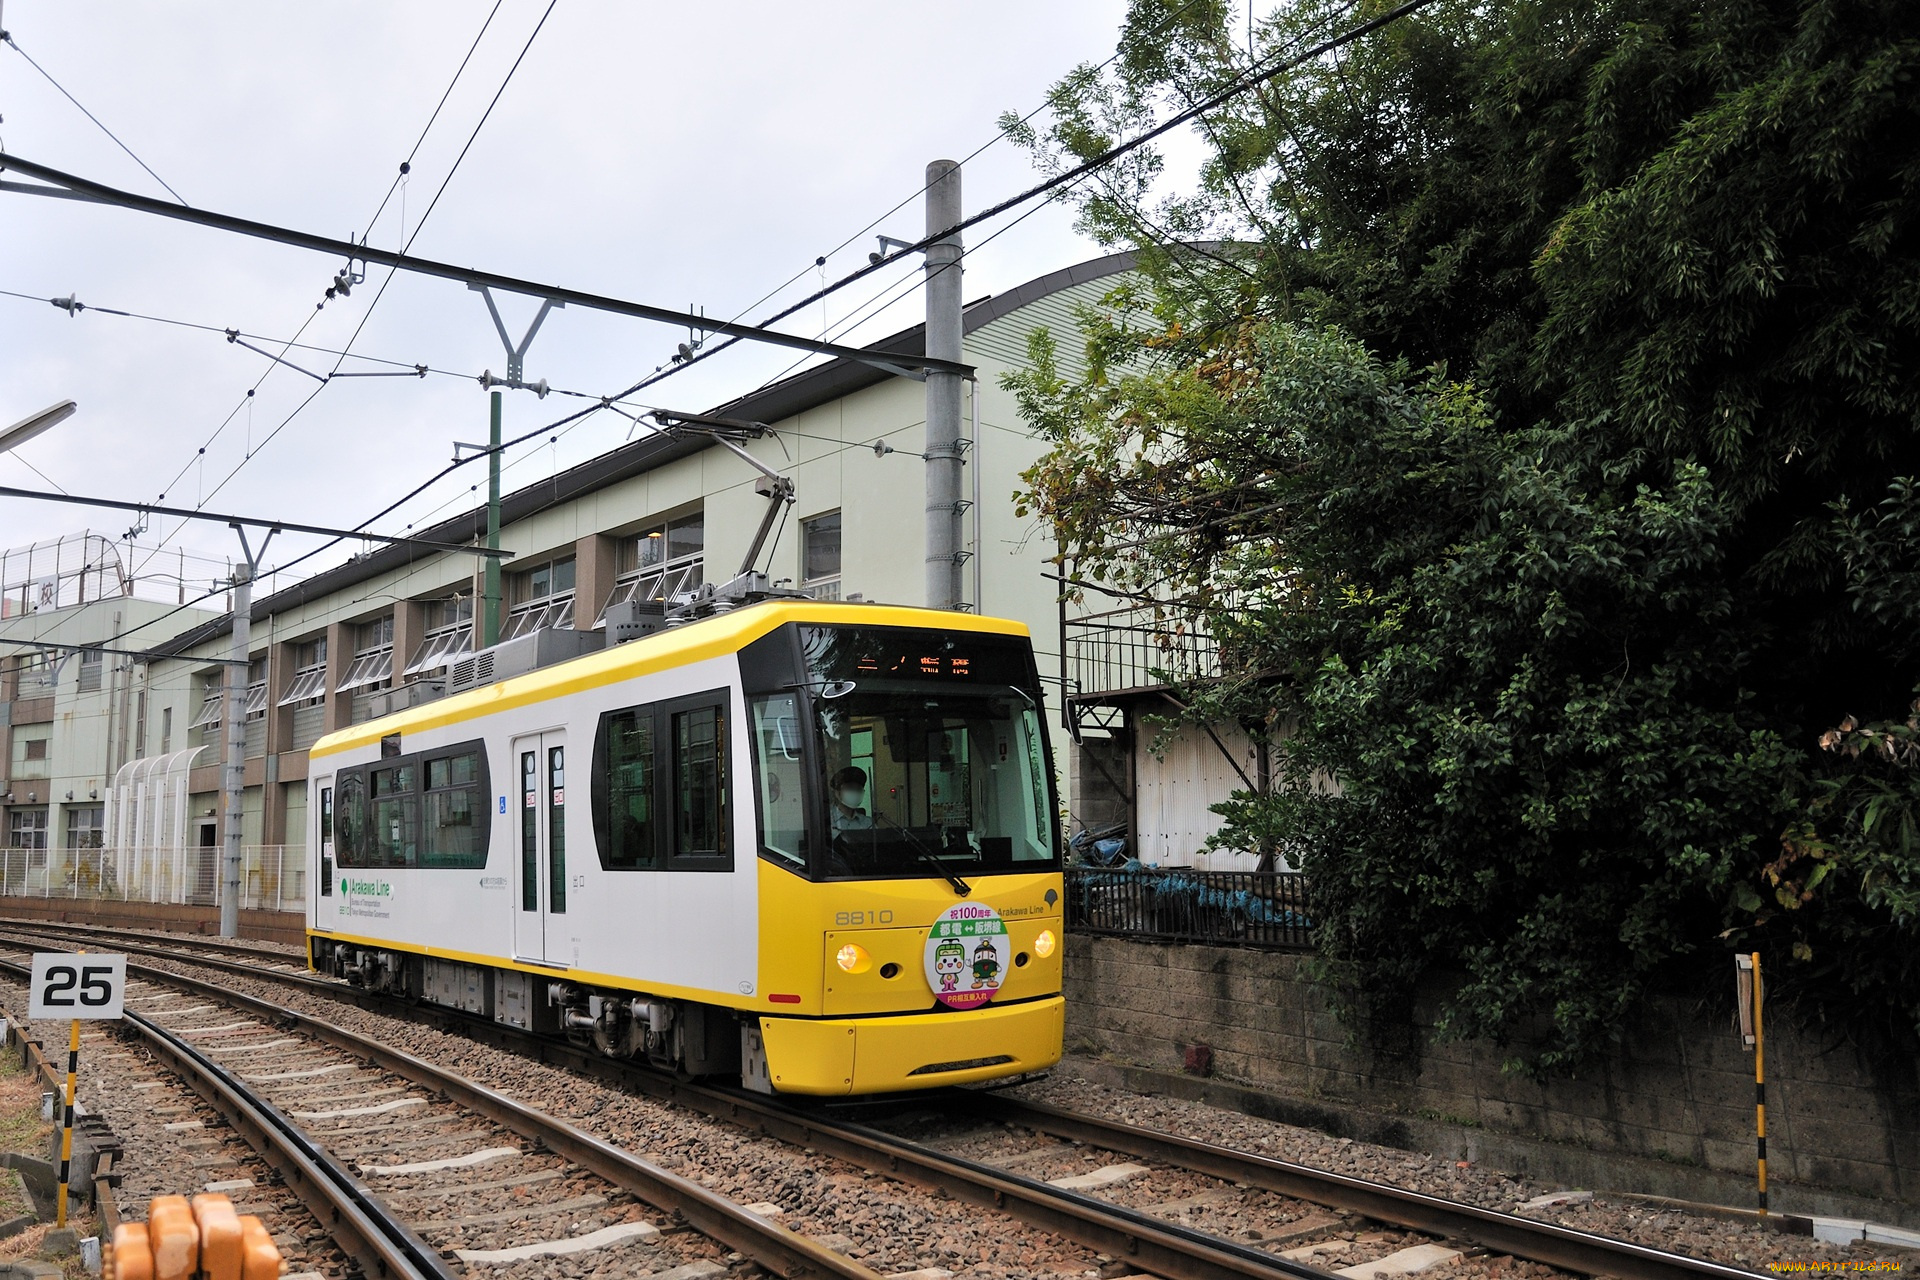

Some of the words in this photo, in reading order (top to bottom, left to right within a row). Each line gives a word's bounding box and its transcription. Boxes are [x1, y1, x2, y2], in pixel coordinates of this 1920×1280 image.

[351, 878, 375, 895] Arakawa
[376, 879, 390, 896] Line
[835, 909, 894, 926] 8810
[997, 906, 1028, 916] Arakawa
[1030, 904, 1044, 914] Line
[43, 965, 113, 1006] 25
